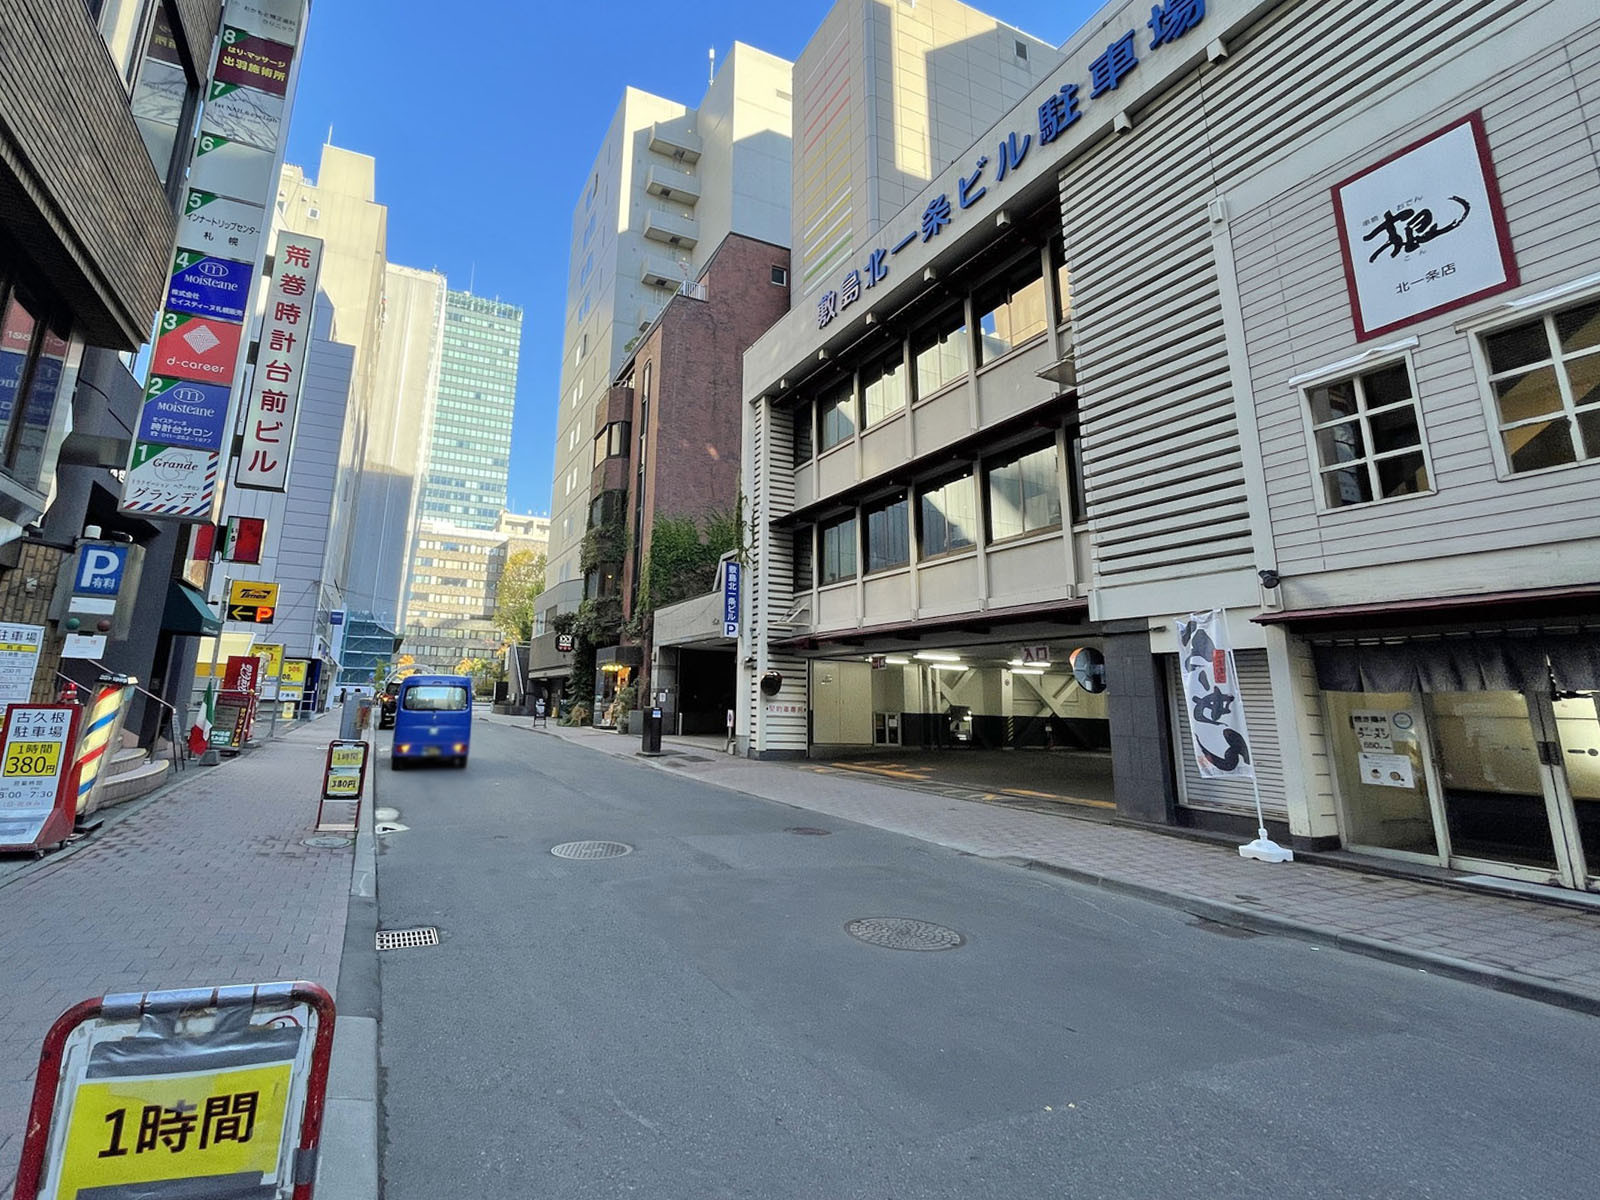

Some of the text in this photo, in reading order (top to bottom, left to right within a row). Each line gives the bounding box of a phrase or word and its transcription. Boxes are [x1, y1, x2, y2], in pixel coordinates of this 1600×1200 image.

[223, 29, 236, 44] 8
[222, 55, 286, 82] 出羽施術所
[213, 81, 226, 96] 7
[201, 136, 214, 151] 6
[188, 193, 203, 208] 5
[1396, 195, 1423, 210] おでん
[186, 212, 261, 235] インナートリップセンター
[176, 252, 189, 268] 4
[1395, 262, 1457, 295] 北一条店
[171, 288, 200, 300] 株式会社
[163, 313, 177, 330] 3
[166, 357, 225, 374] d-career
[247, 245, 310, 473] 荒巻時計台前ビル
[148, 377, 162, 395] 2
[150, 422, 214, 438] 時計台サロン
[138, 444, 148, 462] 1
[152, 457, 199, 471] Grande
[132, 486, 198, 505] グランデ
[80, 549, 119, 587] P
[92, 577, 116, 589] 有料
[255, 606, 273, 623] P
[726, 624, 736, 635] P
[16, 711, 66, 724] 古久根
[13, 726, 63, 738] 駐車場
[17, 744, 53, 755] 1時間
[6, 756, 56, 774] 380円
[98, 1090, 260, 1159] 1時間
